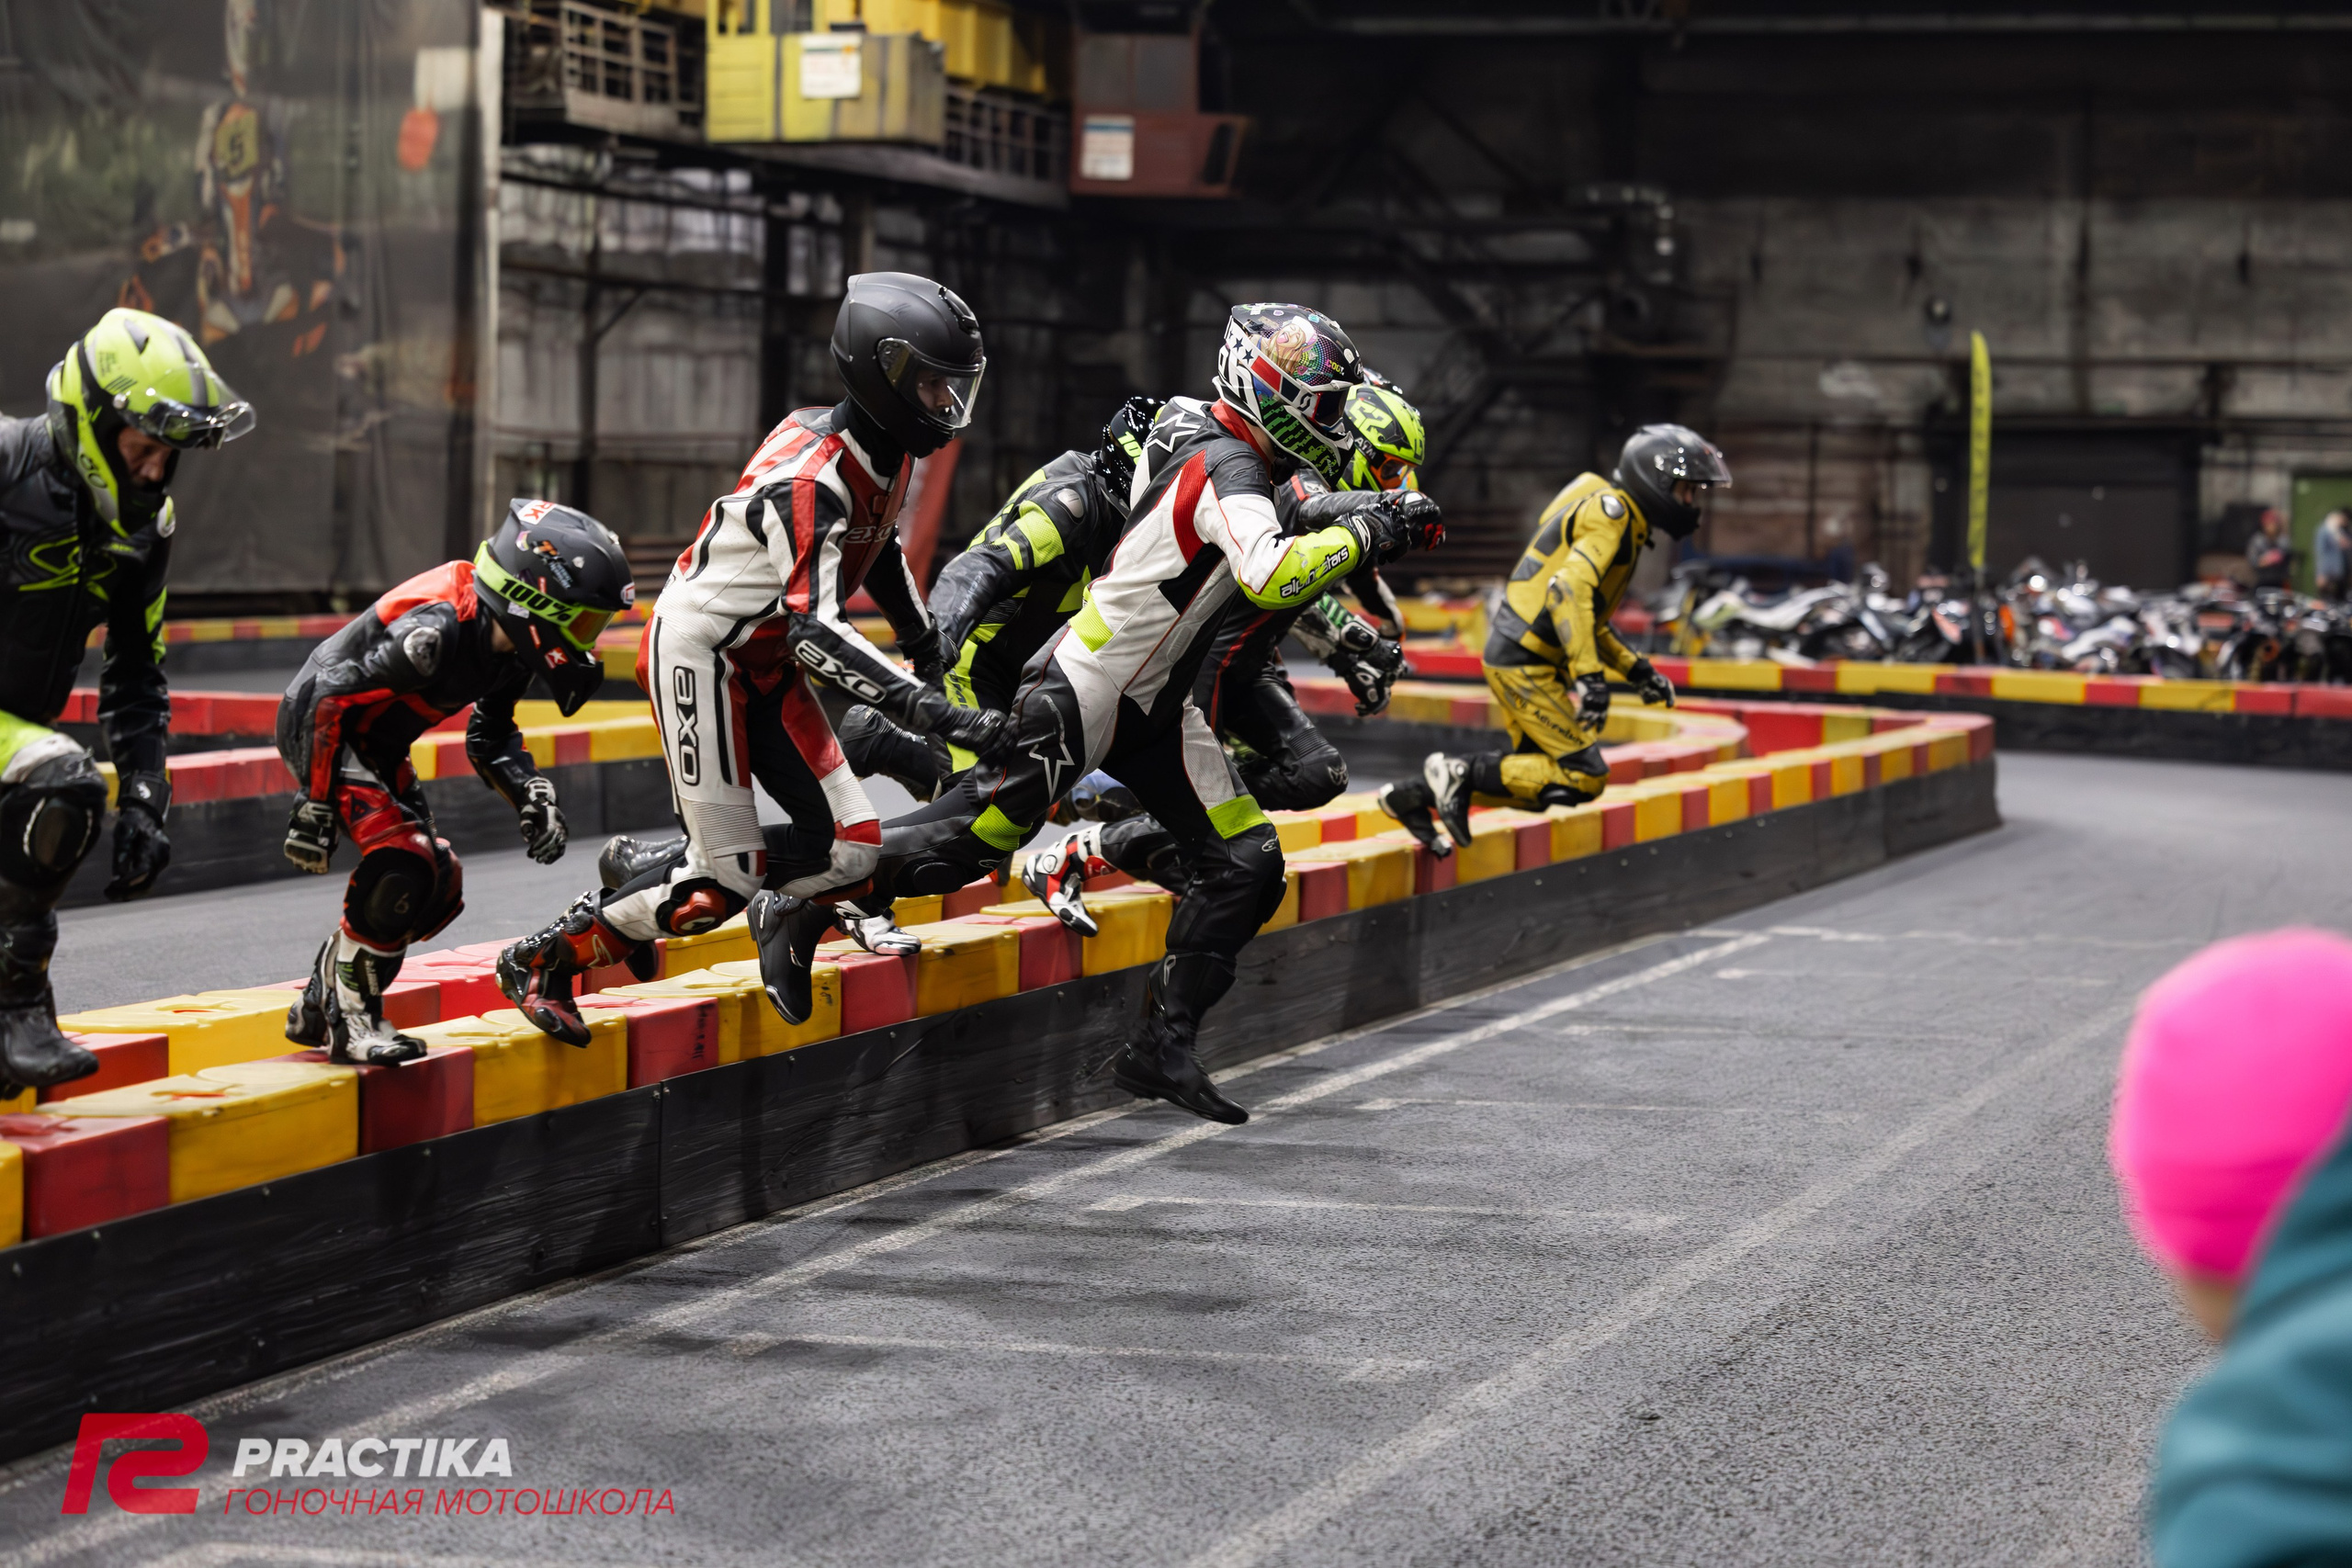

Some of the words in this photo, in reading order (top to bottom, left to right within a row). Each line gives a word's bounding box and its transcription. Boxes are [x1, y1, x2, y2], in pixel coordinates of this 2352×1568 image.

[1349, 399, 1394, 443] 52
[1280, 546, 1350, 598] alpnstars
[499, 579, 573, 622] 100%
[795, 639, 888, 705] axo
[673, 666, 700, 787] axo
